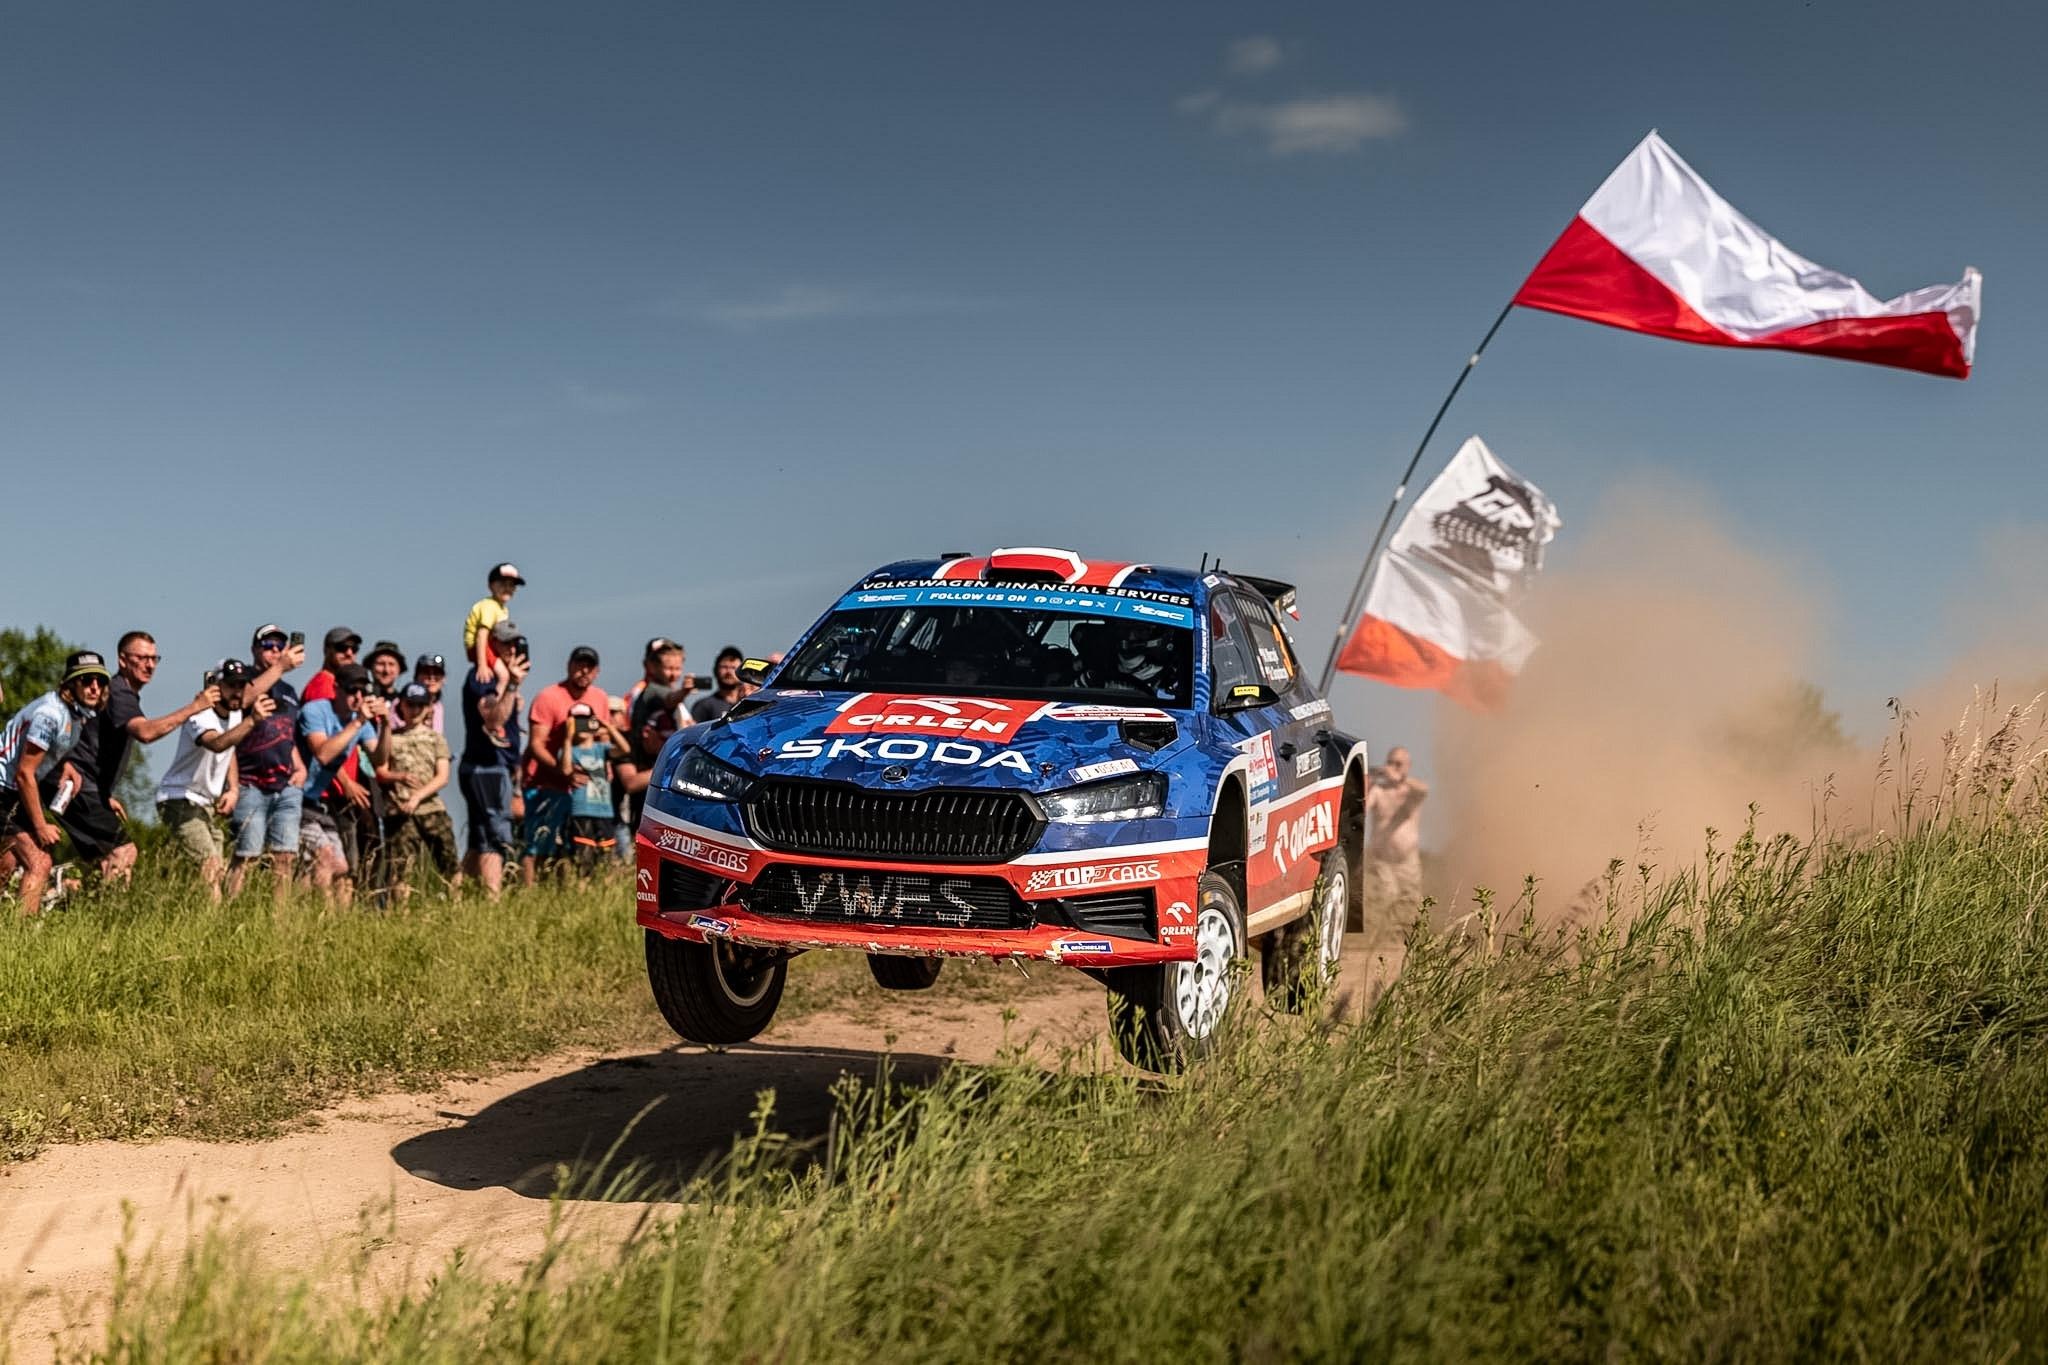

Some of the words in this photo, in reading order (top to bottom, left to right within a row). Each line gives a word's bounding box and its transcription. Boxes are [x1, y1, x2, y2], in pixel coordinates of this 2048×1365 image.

[863, 580, 989, 590] VOLKSWAGEN
[995, 581, 1100, 594] FINANCIAL
[1106, 587, 1190, 605] SERVICES
[929, 592, 983, 600] FOLLOW
[985, 593, 1004, 601] US
[1007, 594, 1027, 602] ON
[848, 714, 1009, 734] ORLEN
[1290, 801, 1333, 862] ORLEN
[708, 849, 748, 872] CARS
[1109, 863, 1161, 882] CARS
[637, 892, 657, 902] ORLEN
[1160, 926, 1194, 936] ORLEN
